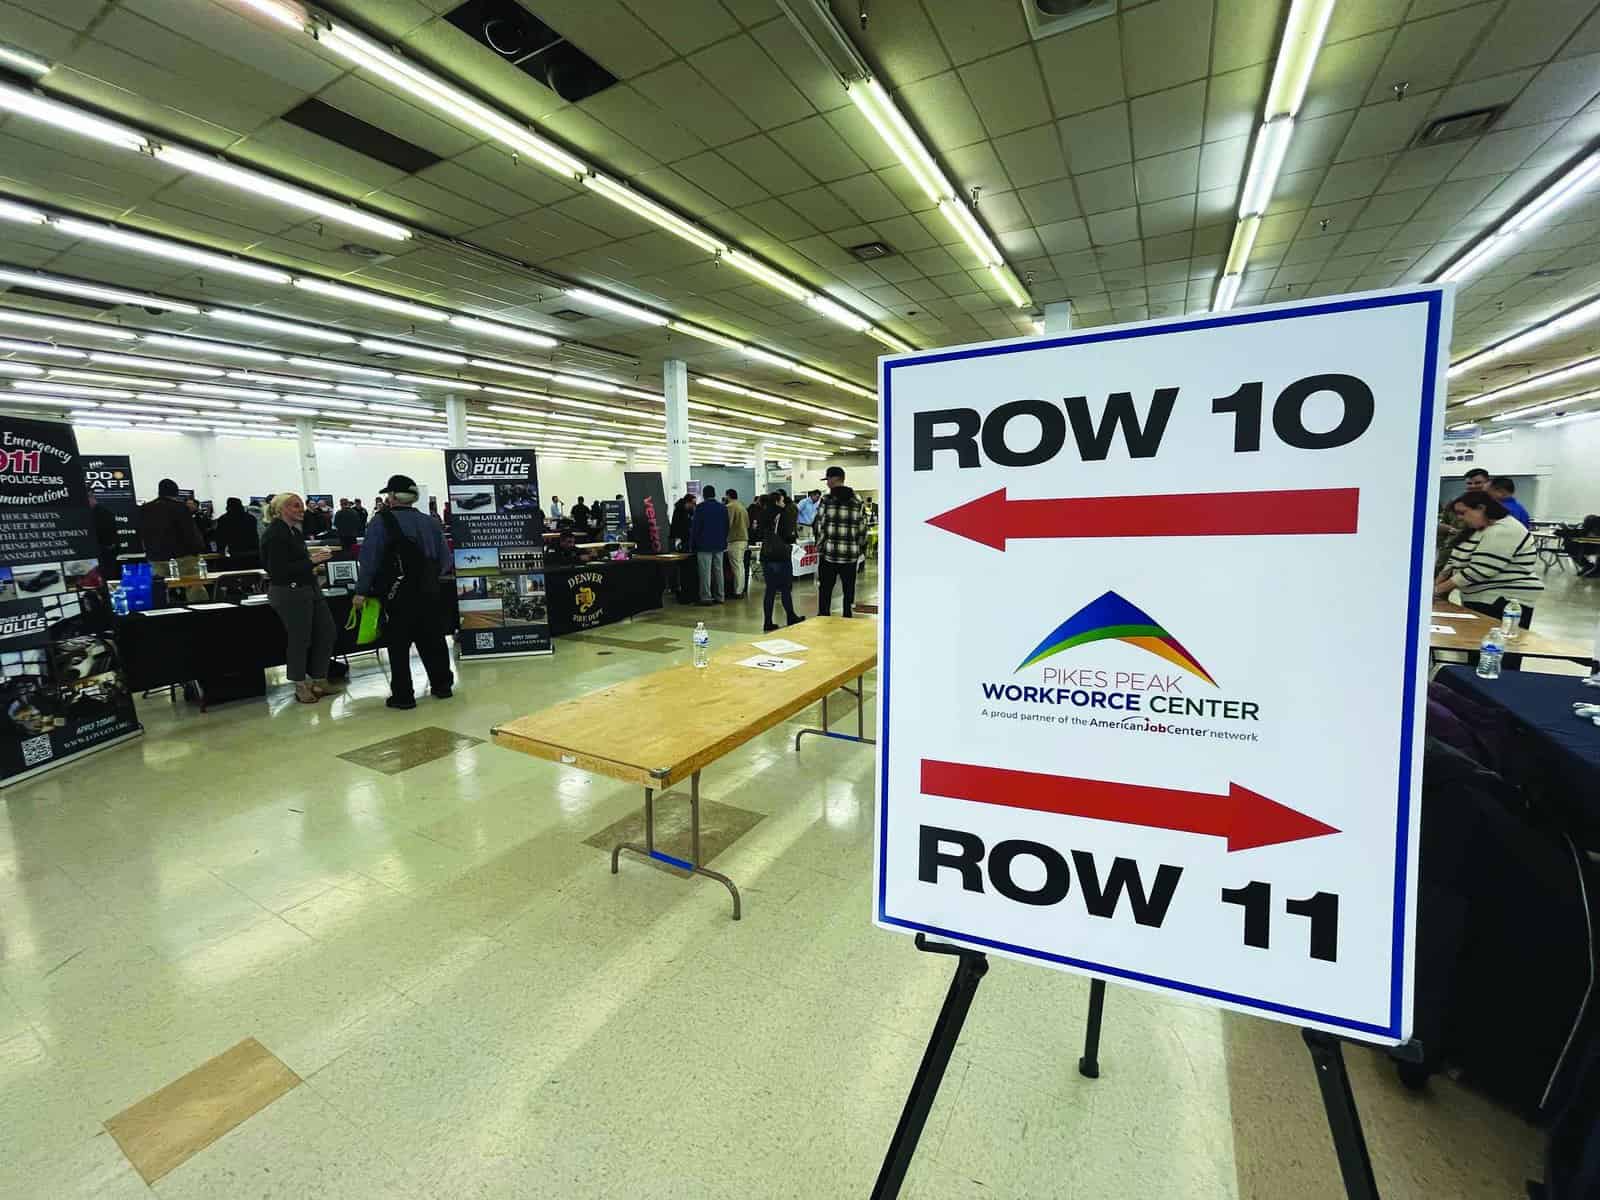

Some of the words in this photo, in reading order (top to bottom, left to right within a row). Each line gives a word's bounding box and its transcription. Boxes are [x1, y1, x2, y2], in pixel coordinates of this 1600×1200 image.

[914, 387, 1180, 471] ROW
[1212, 374, 1374, 452] 10
[3, 431, 72, 464] Emergency
[475, 456, 522, 464] LOVELAND
[473, 463, 531, 475] POLICE
[0, 543, 28, 552] IRING
[568, 572, 603, 589] DENVER
[1043, 667, 1108, 688] PIKES
[1115, 671, 1182, 694] PEAK
[982, 683, 1141, 711] WORKFORCE
[1149, 695, 1259, 721] CENTER
[990, 710, 1018, 720] proud
[1020, 713, 1056, 723] partner
[1058, 715, 1069, 724] of
[1071, 716, 1088, 726] the
[1210, 729, 1259, 742] network
[918, 824, 1183, 928] ROW
[1222, 881, 1339, 962] 11
